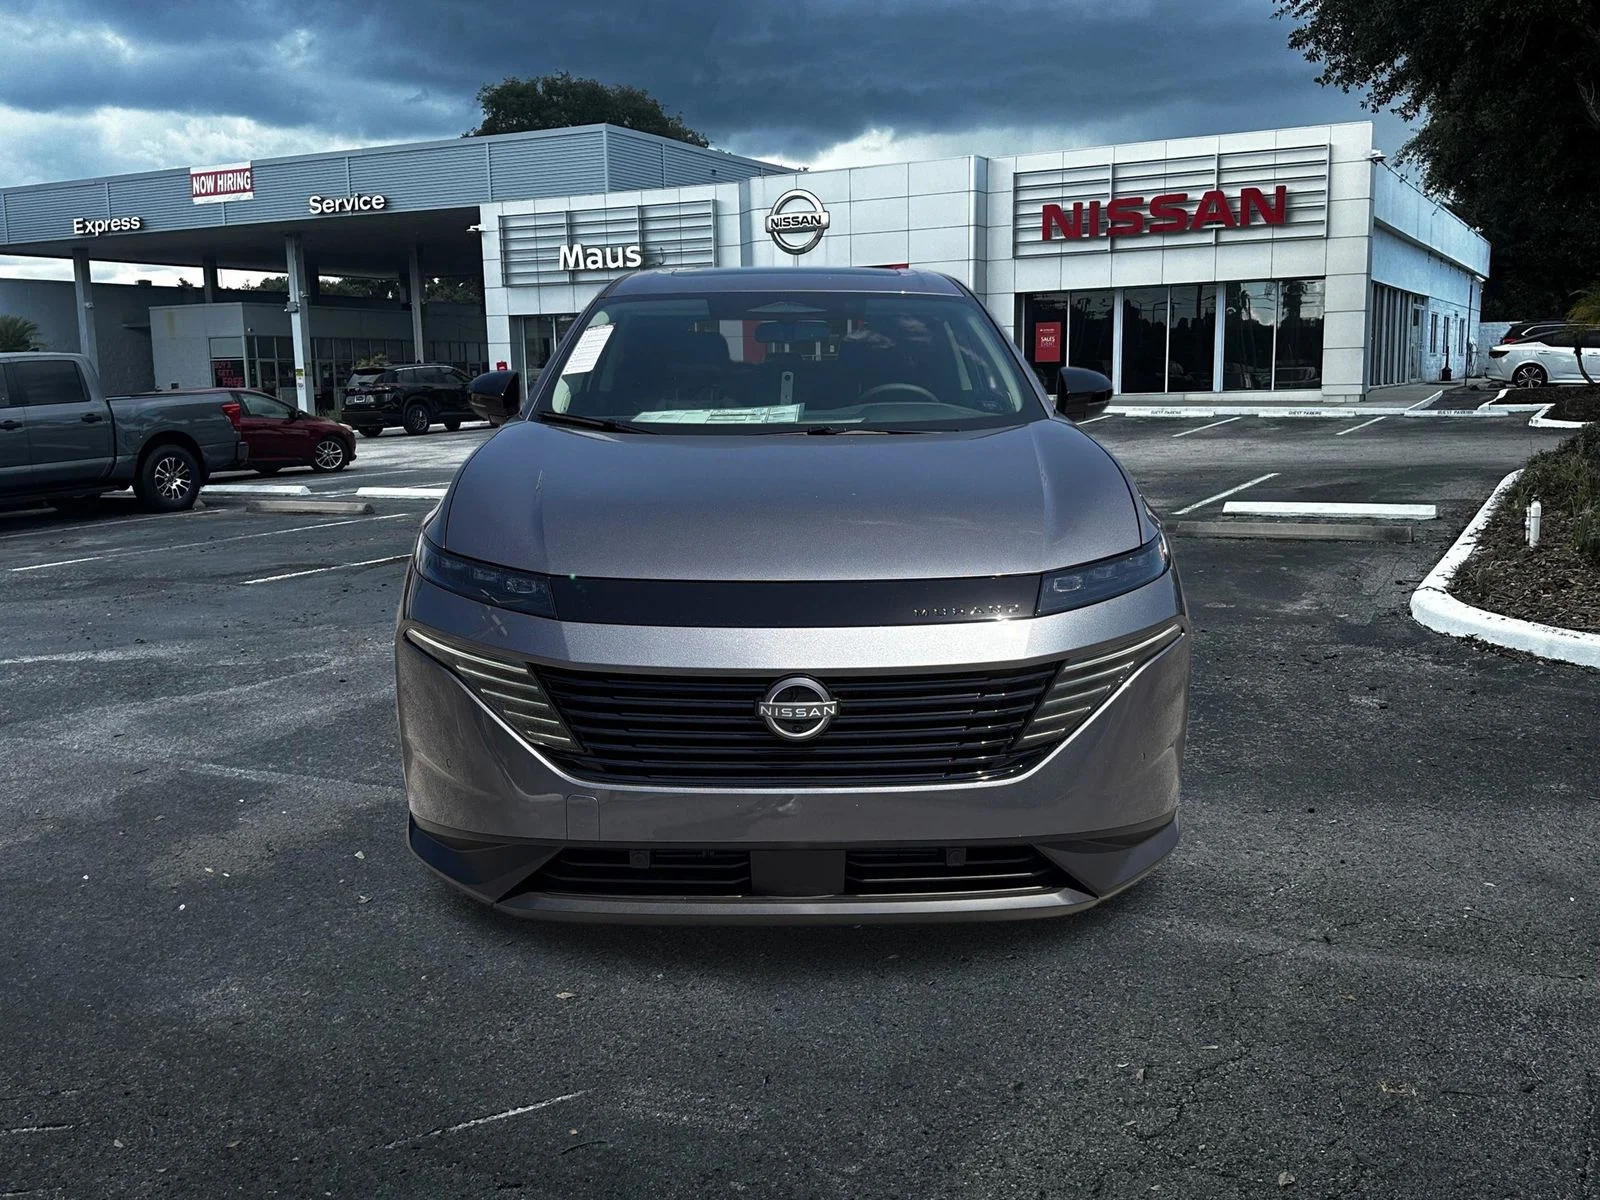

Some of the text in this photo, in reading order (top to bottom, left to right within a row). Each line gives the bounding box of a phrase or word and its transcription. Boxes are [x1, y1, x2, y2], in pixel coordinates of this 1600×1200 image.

[192, 171, 251, 195] NOW HIRING
[309, 193, 385, 214] Service
[1042, 185, 1287, 241] NISSAN
[73, 216, 141, 237] Express
[770, 214, 822, 229] NISSAN
[559, 243, 642, 271] Maus
[760, 705, 835, 718] NISSAN
